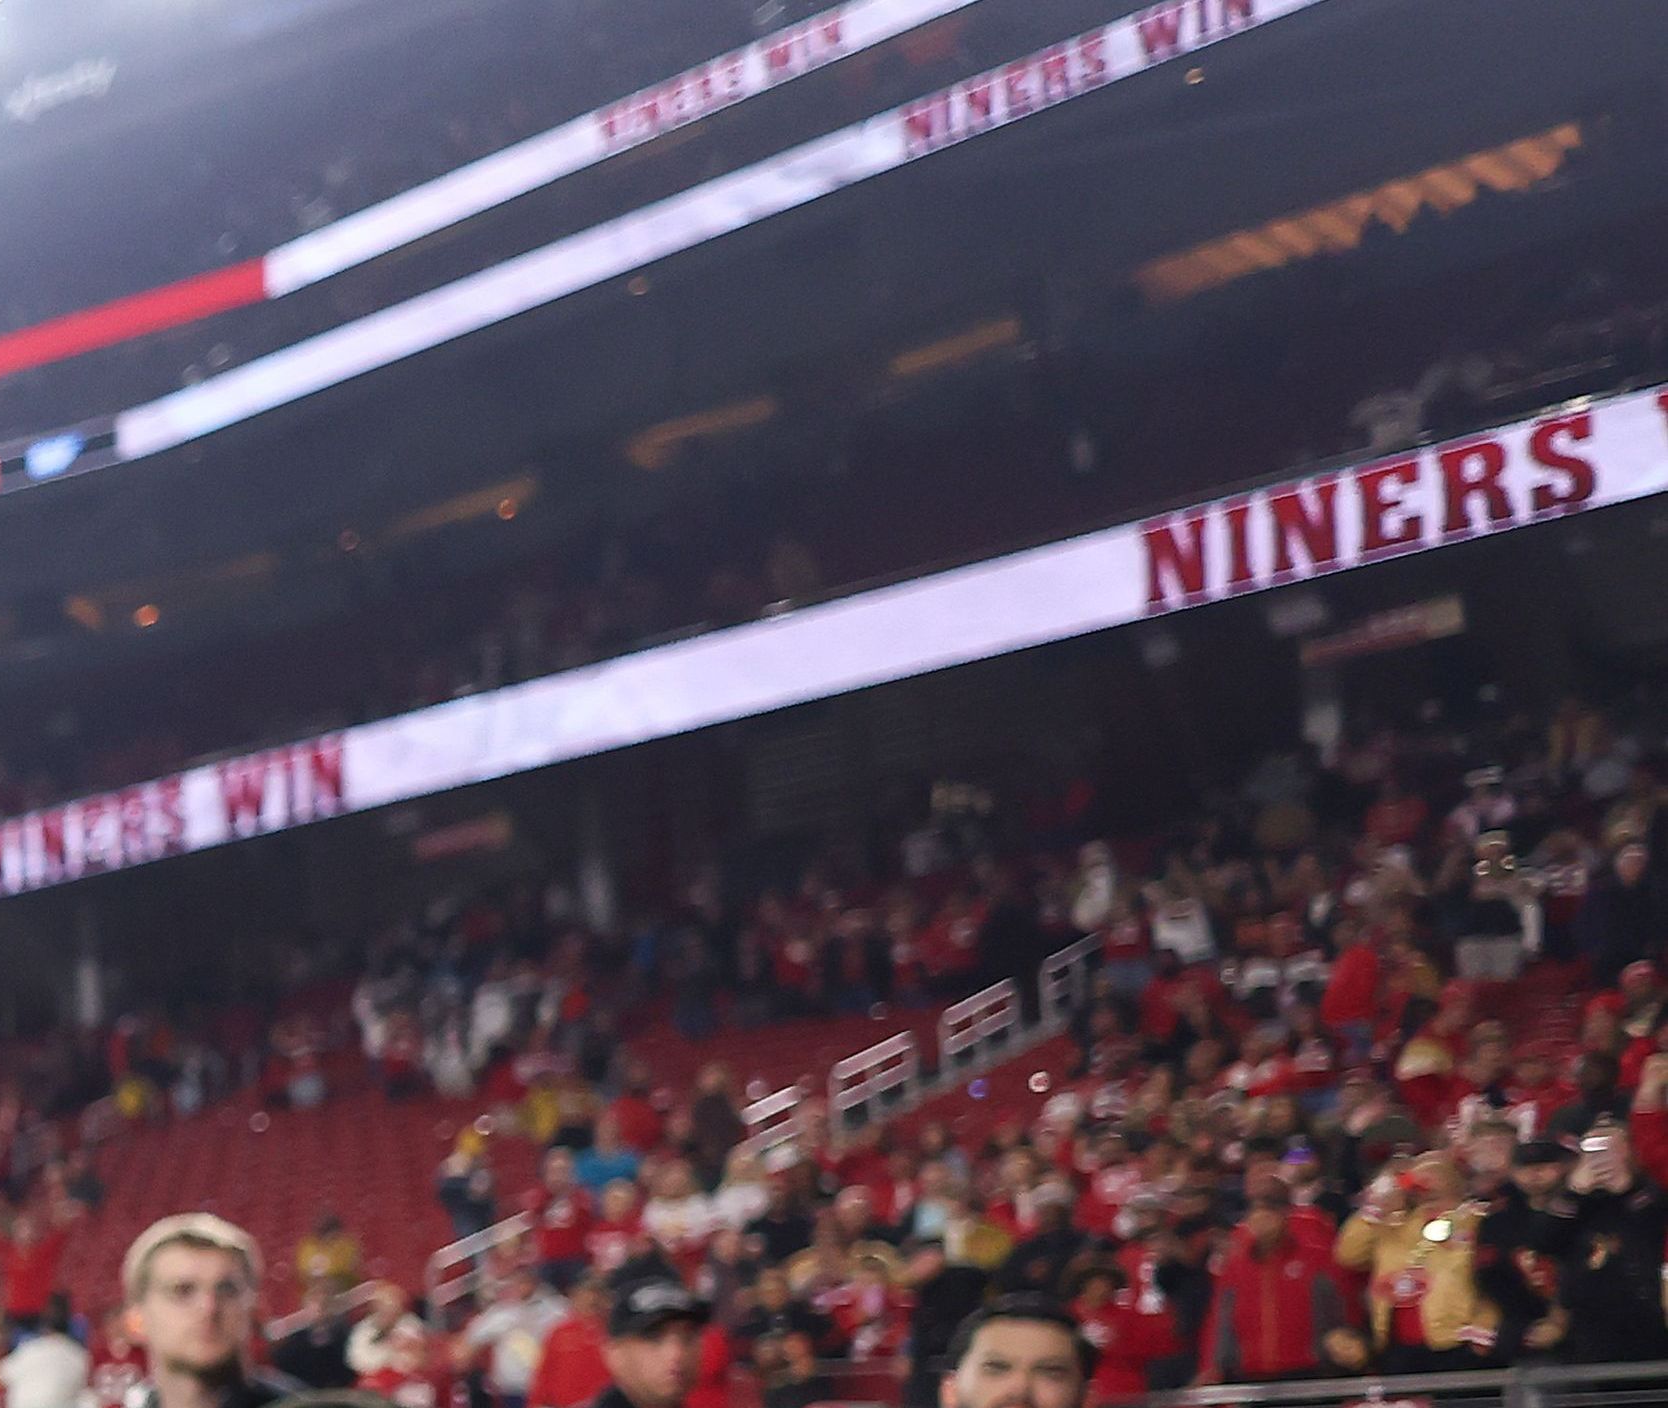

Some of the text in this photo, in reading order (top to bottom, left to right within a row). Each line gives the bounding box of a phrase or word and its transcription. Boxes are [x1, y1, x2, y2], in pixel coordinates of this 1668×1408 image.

[903, 33, 1107, 153] NINERS
[1141, 410, 1597, 606] NINERS
[219, 738, 344, 835] WIN
